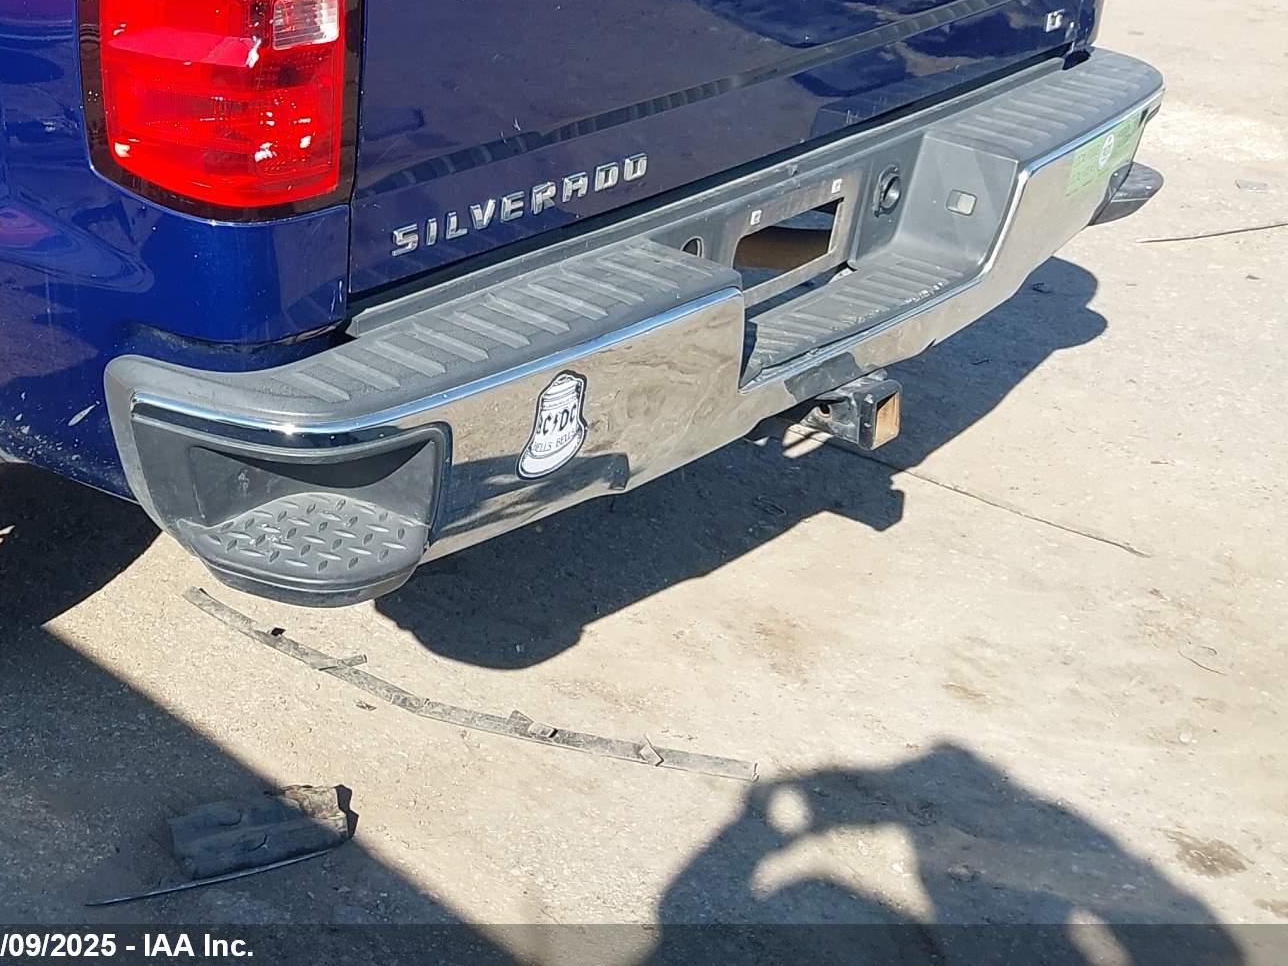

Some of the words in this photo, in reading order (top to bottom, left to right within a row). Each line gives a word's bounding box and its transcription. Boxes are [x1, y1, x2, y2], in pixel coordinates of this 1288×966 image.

[392, 152, 649, 256] SILVERADO
[532, 440, 553, 452] HELLS
[555, 430, 577, 448] BELLS
